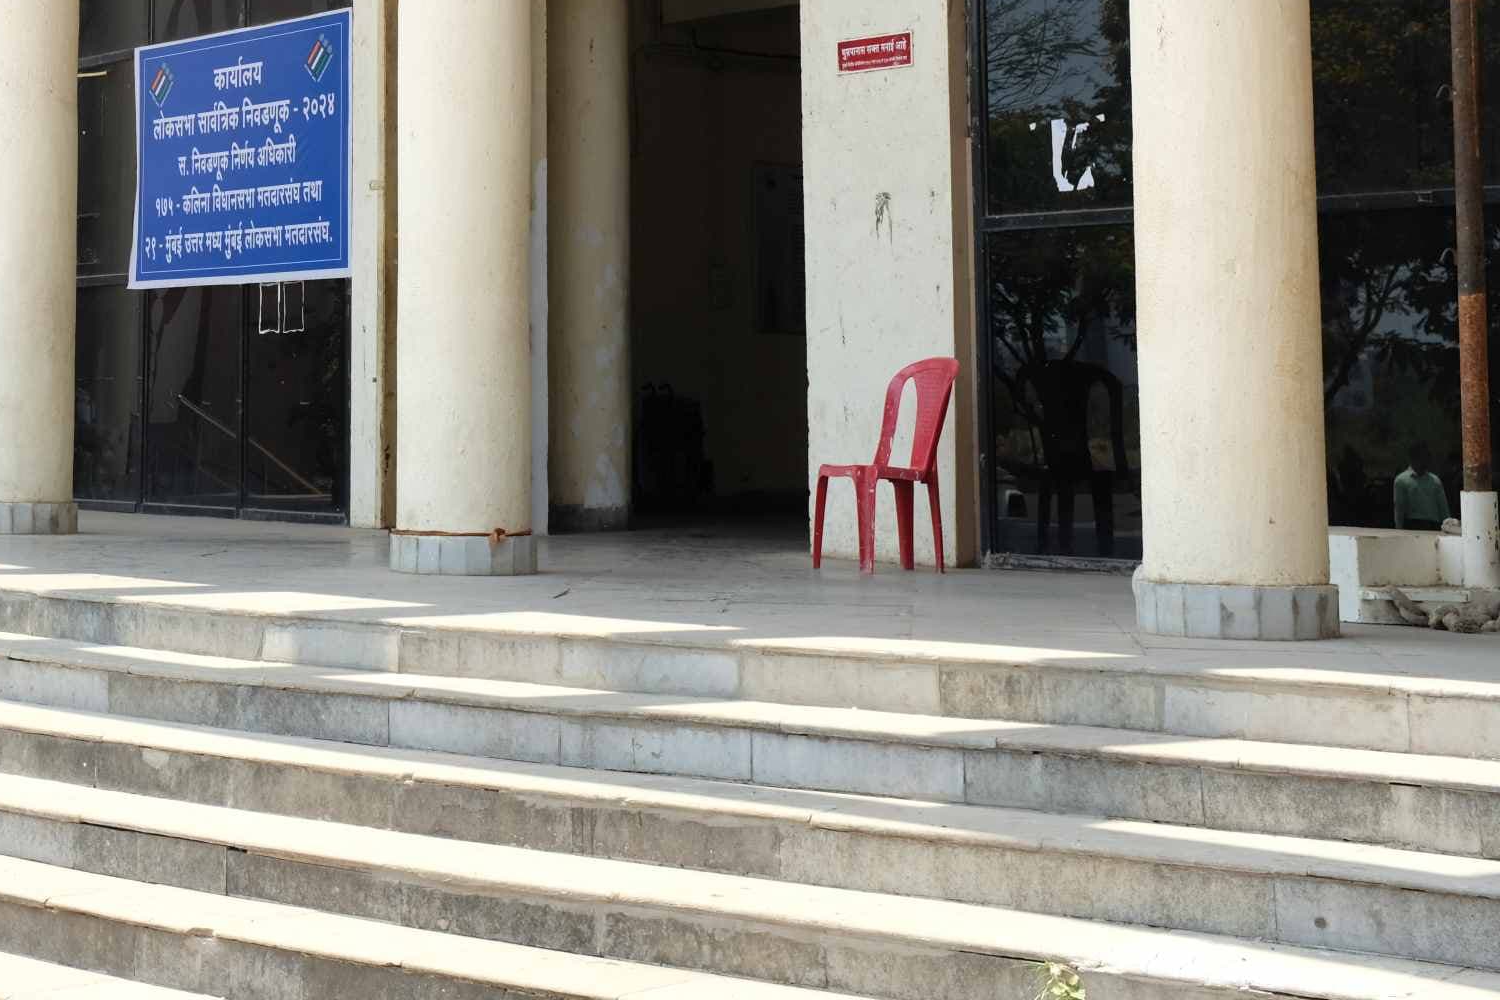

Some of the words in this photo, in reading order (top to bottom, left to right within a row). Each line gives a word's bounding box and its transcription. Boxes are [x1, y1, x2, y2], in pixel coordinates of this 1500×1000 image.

[213, 56, 263, 91] कार्यालय
[153, 110, 195, 141] लोकसभा
[197, 100, 239, 134] सार्वत्रिक
[242, 97, 290, 134] निवडणूक
[302, 92, 335, 121] २०२४
[178, 156, 189, 176] स.
[191, 147, 229, 181] निवडणूक
[231, 140, 255, 171] निर्णय
[257, 133, 296, 167] अधिकारी
[155, 197, 174, 217] १७५
[182, 186, 210, 216] कलिना
[212, 183, 255, 213] विधानसभा
[257, 177, 300, 207] मतदारसंघ
[302, 179, 322, 202] तथा
[165, 226, 182, 263] मुंबई
[184, 233, 203, 254] उत्तर
[205, 231, 222, 251] मध्य
[224, 222, 242, 260] मुंबई
[245, 220, 282, 250] लोकसभा
[285, 216, 333, 247] मतदारसंघ.
